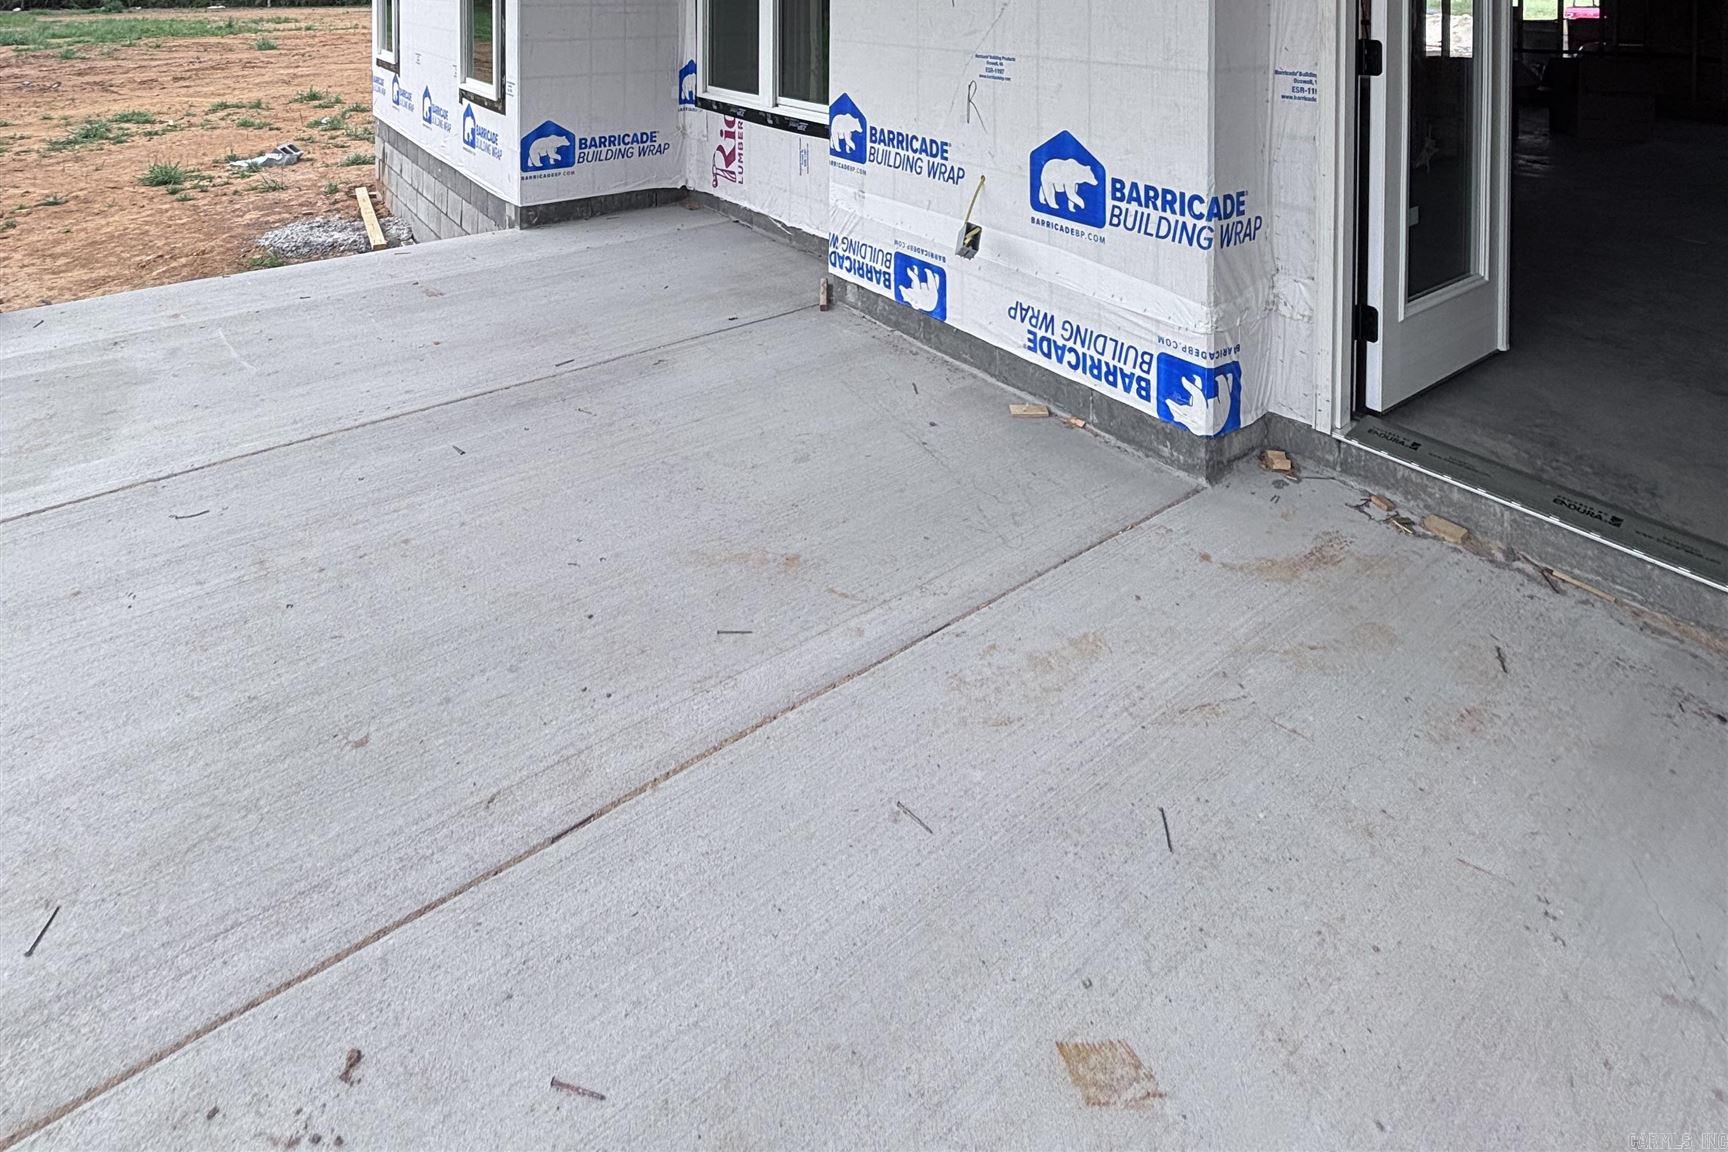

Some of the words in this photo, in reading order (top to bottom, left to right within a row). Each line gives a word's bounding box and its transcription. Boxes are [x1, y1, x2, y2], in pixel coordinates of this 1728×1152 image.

[967, 80, 988, 135] R
[577, 147, 634, 165] BUILDING
[637, 142, 670, 158] WRAP
[578, 131, 658, 150] BARRICADE
[869, 125, 950, 162] BARRICADE
[868, 146, 923, 176] BUILDING
[927, 159, 966, 186] WRAP
[1111, 177, 1247, 222] BARRICADE
[1030, 216, 1106, 245] BARRICADEBP.COM
[1109, 204, 1215, 251] BUILDING
[1219, 215, 1263, 249] WRAP
[841, 237, 893, 270] BUILDING
[1007, 300, 1056, 336] WRAP
[1024, 329, 1152, 403] BARRICADE
[1060, 319, 1154, 375] BUILDING
